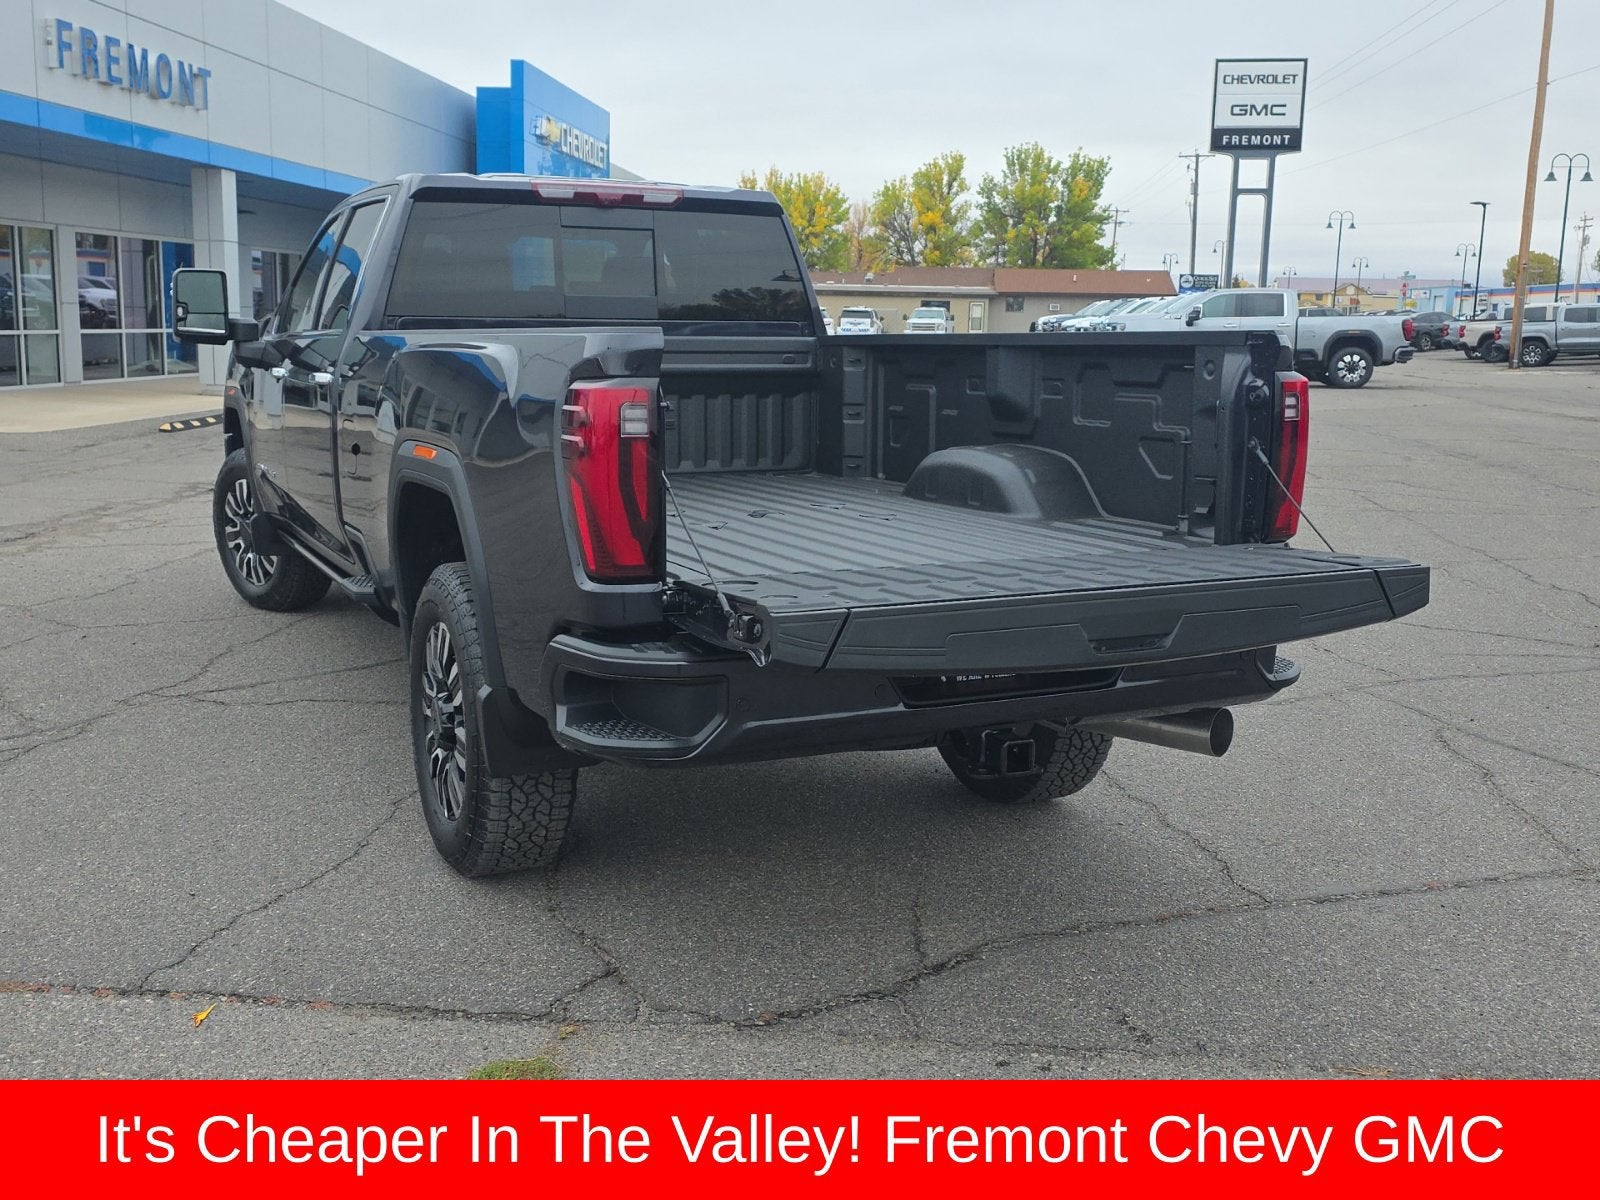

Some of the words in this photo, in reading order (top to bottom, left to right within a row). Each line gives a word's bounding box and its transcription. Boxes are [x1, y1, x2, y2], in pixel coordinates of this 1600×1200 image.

[53, 17, 212, 111] FREMONT
[1222, 74, 1298, 85] CHEVROLET
[1230, 104, 1287, 116] GMC
[560, 122, 608, 170] CHEVROLET
[1222, 134, 1291, 146] FREMONT
